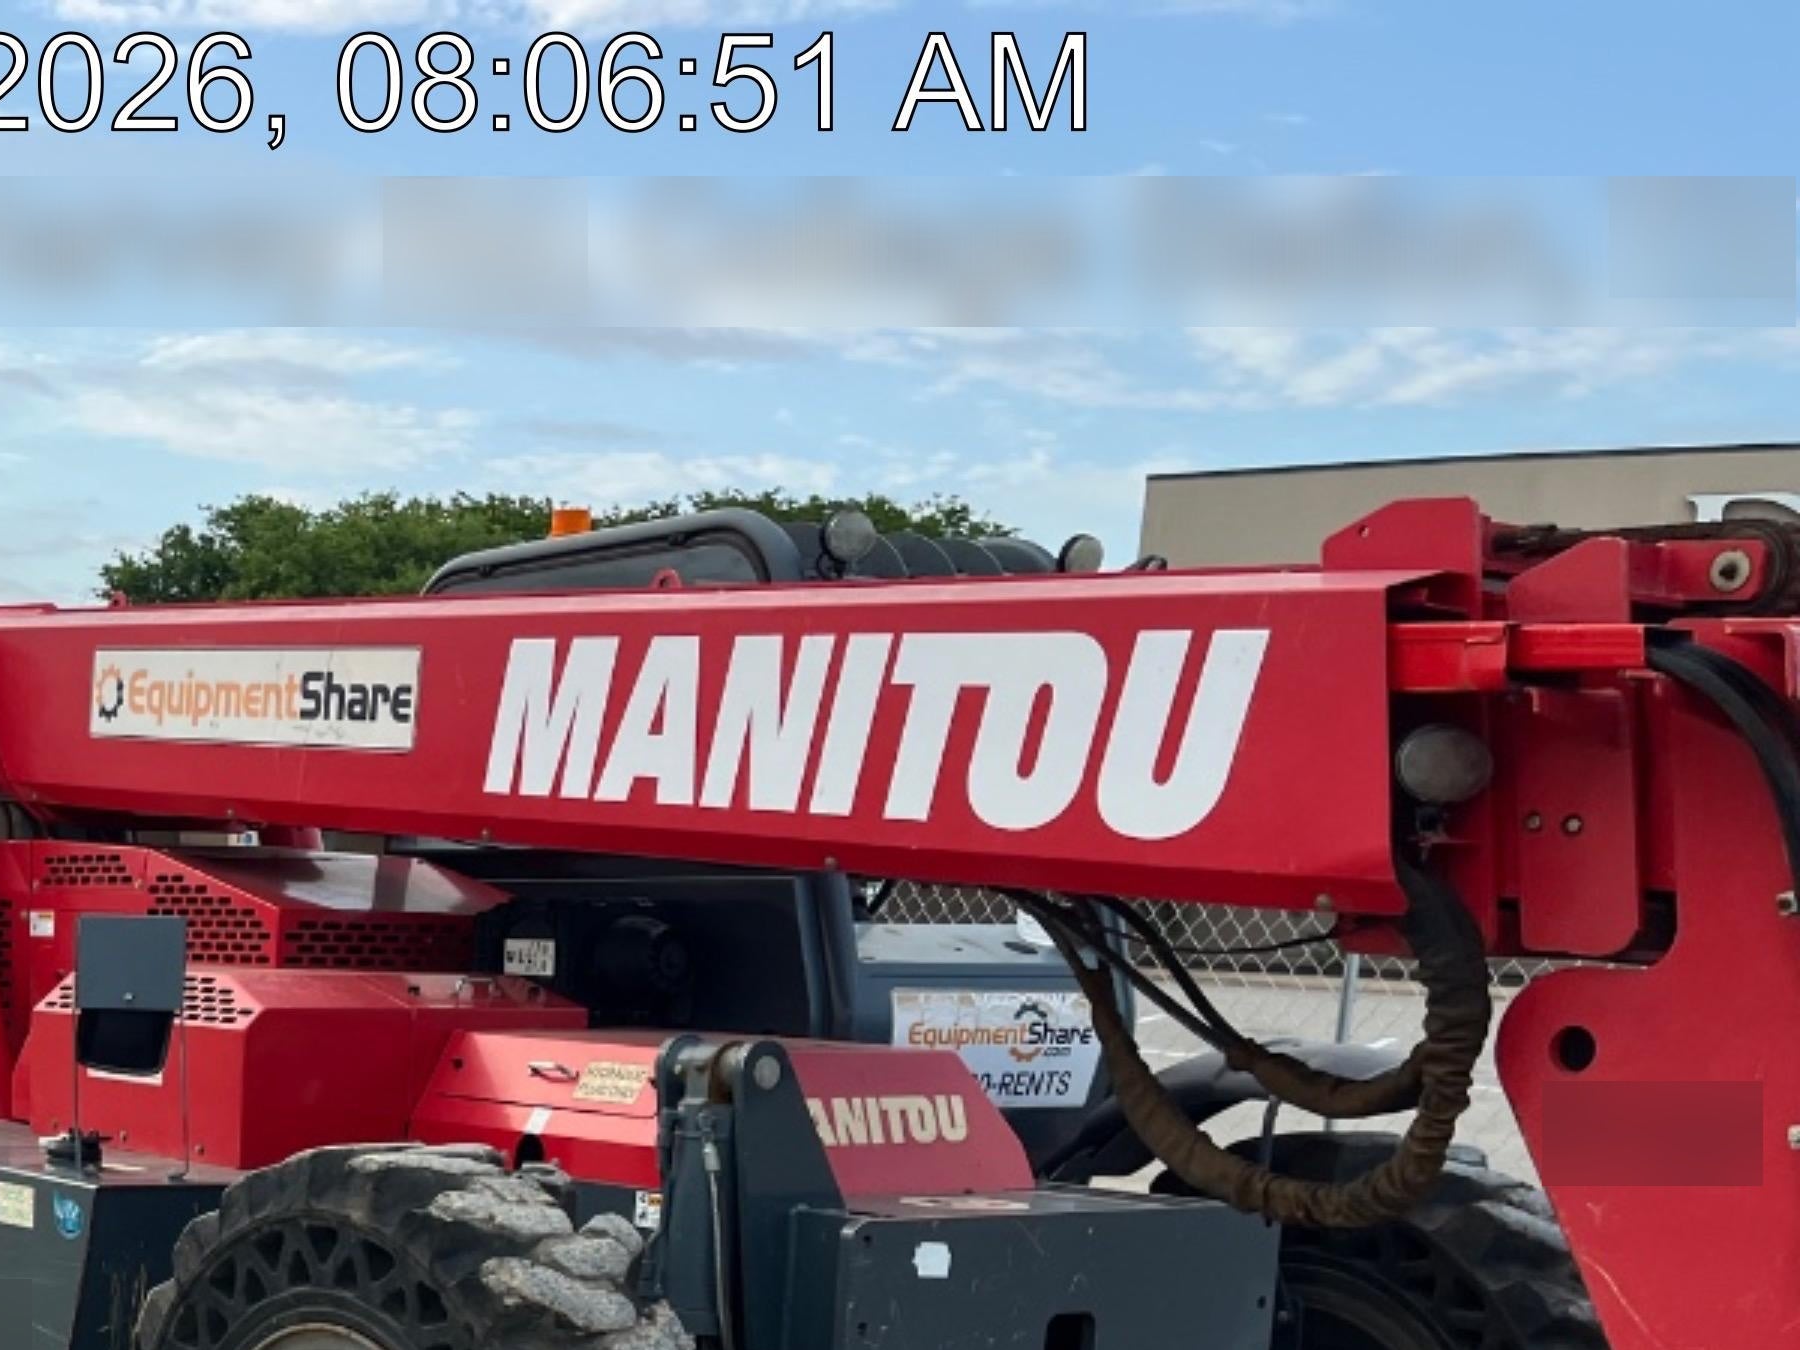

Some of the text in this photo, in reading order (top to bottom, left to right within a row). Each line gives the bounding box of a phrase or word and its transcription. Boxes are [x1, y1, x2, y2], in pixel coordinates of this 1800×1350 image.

[128, 669, 413, 727] EquipmentShare
[483, 629, 1270, 839] MANITOU
[908, 1021, 1092, 1050] EquipmentShare
